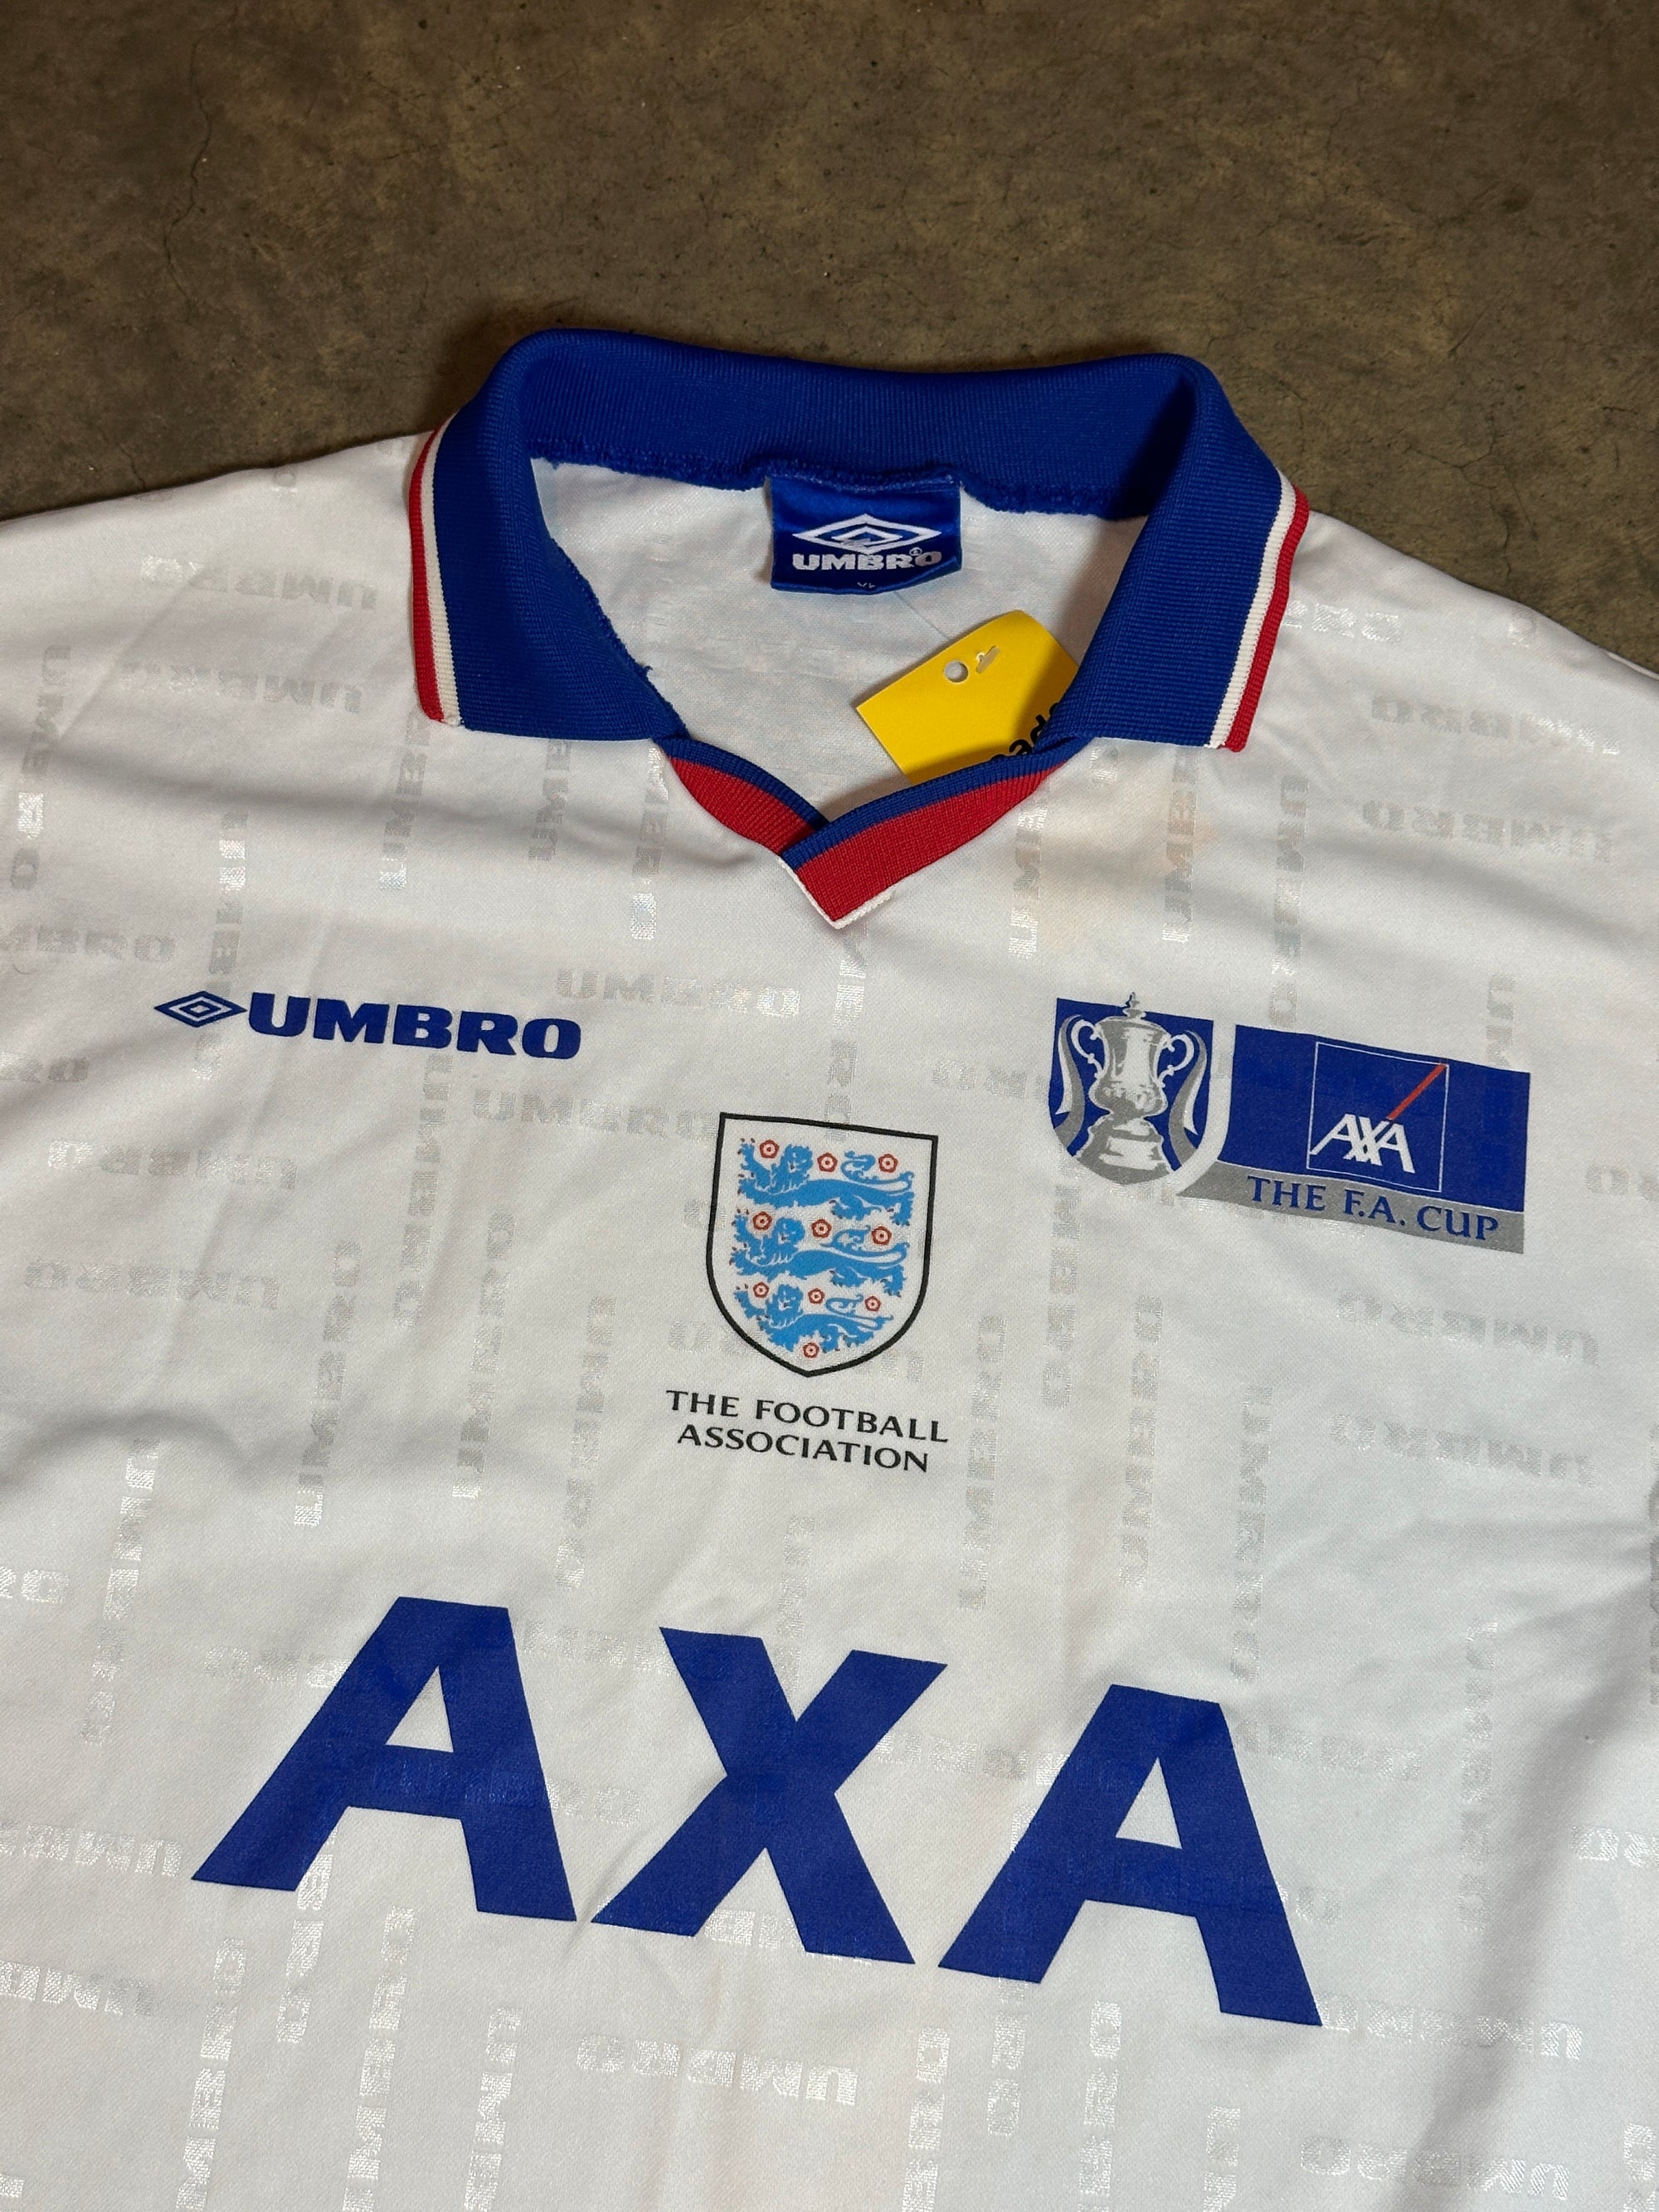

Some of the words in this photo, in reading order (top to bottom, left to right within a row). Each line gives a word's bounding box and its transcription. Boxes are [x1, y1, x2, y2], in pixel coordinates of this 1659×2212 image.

[793, 551, 941, 571] UMBRO
[1362, 800, 1613, 863] UMBRO
[1269, 774, 1312, 1027] UMBRO
[248, 991, 581, 1060] UMBRO
[556, 969, 800, 1018] UMBRO
[472, 1089, 718, 1138] UMBRO
[1309, 1113, 1415, 1174] AXA
[393, 1053, 453, 1329] UMBRO
[1248, 1175, 1326, 1211] THE
[1344, 1189, 1406, 1227] F.A.
[1416, 1205, 1499, 1241] CUP
[452, 1213, 514, 1499] UMBRO
[1337, 1291, 1598, 1366] UMBRO
[292, 1242, 362, 1526] UMBRO
[666, 1390, 740, 1417] THE
[755, 1398, 949, 1443] FOOTBALL
[554, 1294, 617, 1591] UMBRO
[677, 1423, 929, 1474] ASSOCIATION
[958, 1315, 1005, 1611] UMBRO
[1120, 1296, 1162, 1584] UMBRO
[1331, 1414, 1596, 1486] UMBRO
[192, 1596, 1323, 2027] AXA
[577, 2036, 858, 2107] UMBRO
[1301, 2136, 1569, 2200] UMBRO
